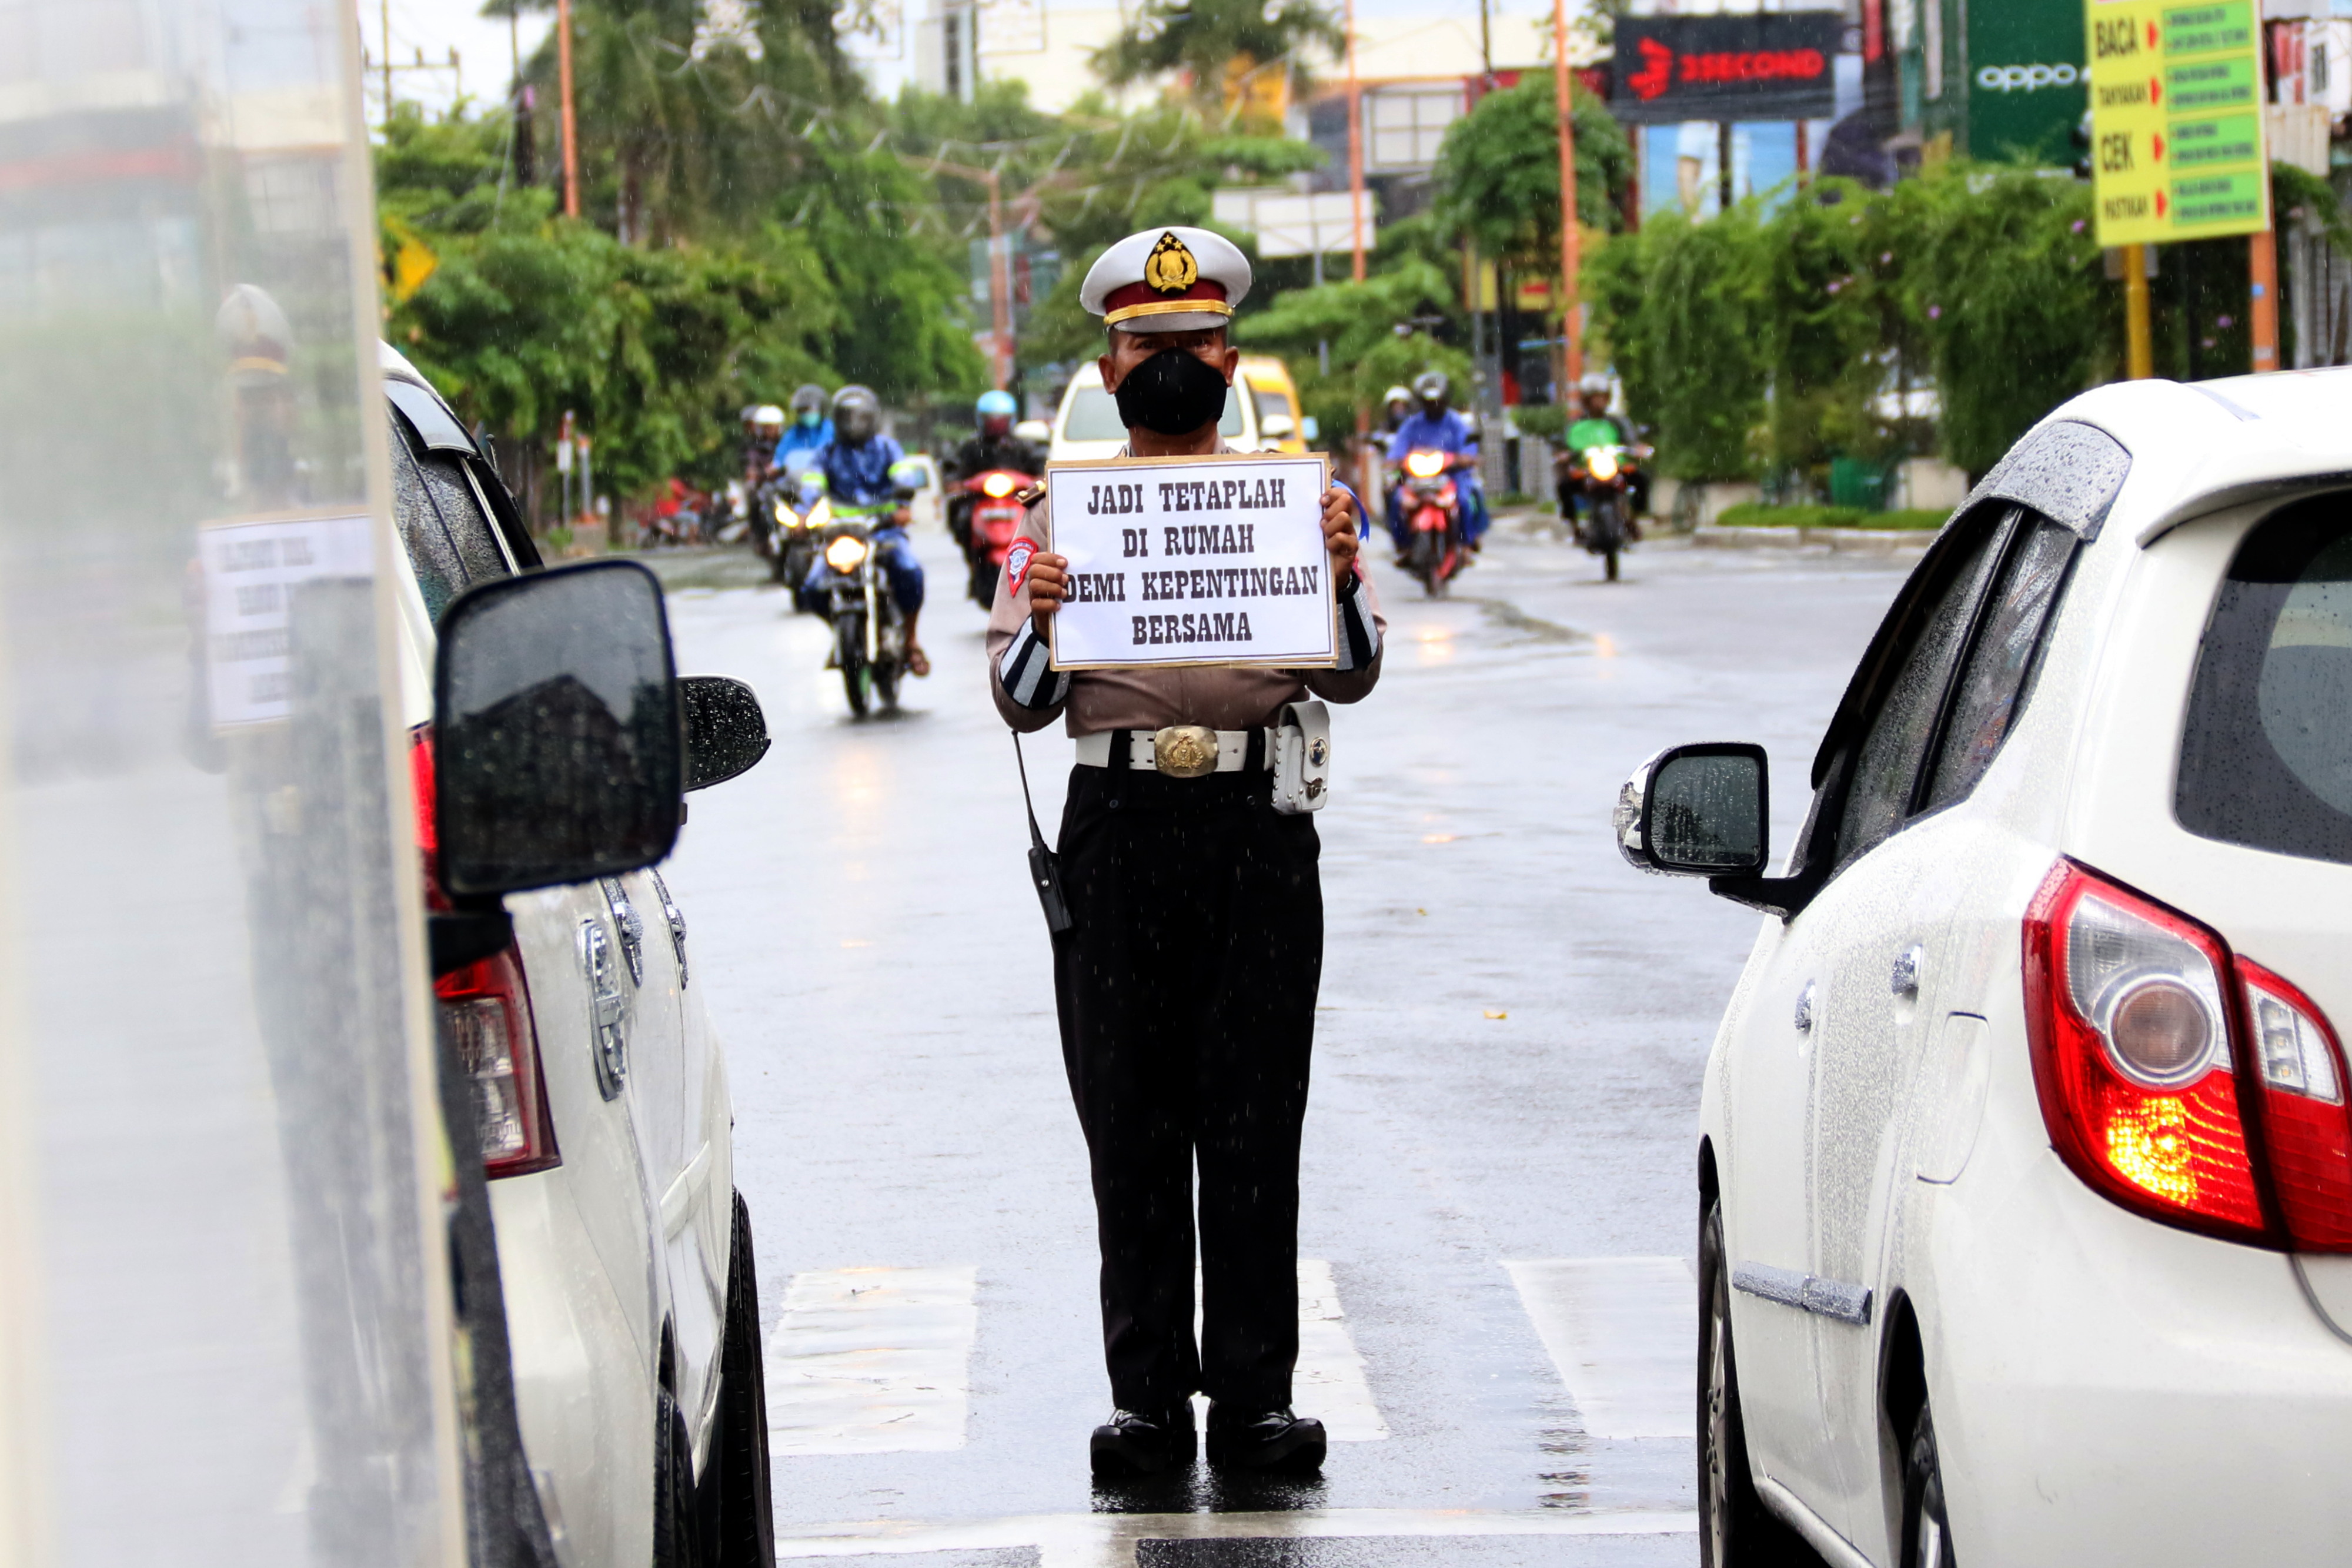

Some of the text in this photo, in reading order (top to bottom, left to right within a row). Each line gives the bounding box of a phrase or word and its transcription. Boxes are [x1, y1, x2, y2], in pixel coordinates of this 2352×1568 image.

[2095, 16, 2138, 58] BACA
[1680, 48, 1824, 81] 3SECOND
[1977, 64, 2077, 92] oppo
[2101, 130, 2134, 173] CEK
[1088, 479, 1285, 514] JADI TETAPLAH
[1122, 524, 1254, 557] DI RUMAH
[1063, 566, 1318, 603] DEMI KEPENTINGAN
[1132, 612, 1252, 645] BERSAMA
